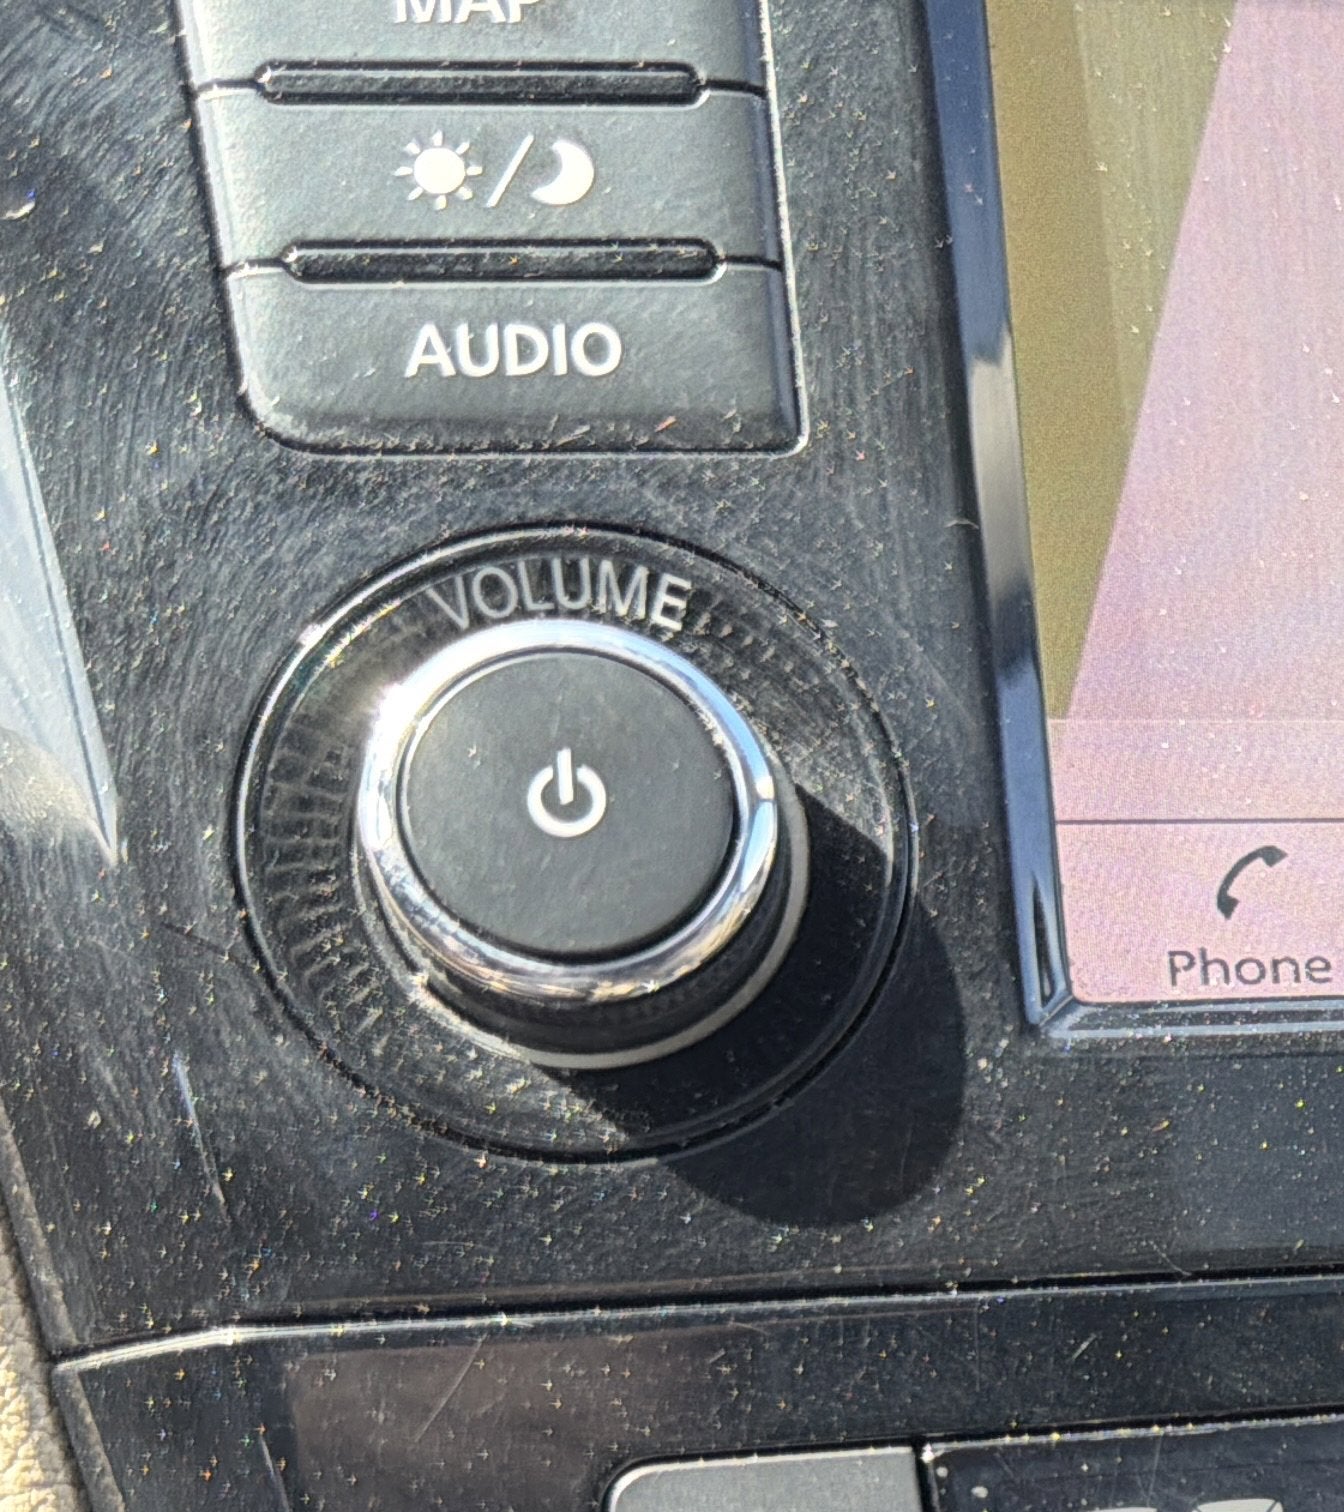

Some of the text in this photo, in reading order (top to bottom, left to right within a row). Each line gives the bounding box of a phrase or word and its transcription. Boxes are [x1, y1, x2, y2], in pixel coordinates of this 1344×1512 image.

[404, 324, 622, 378] AUDIO
[426, 556, 694, 630] VOLUME
[1169, 947, 1333, 986] Phone
